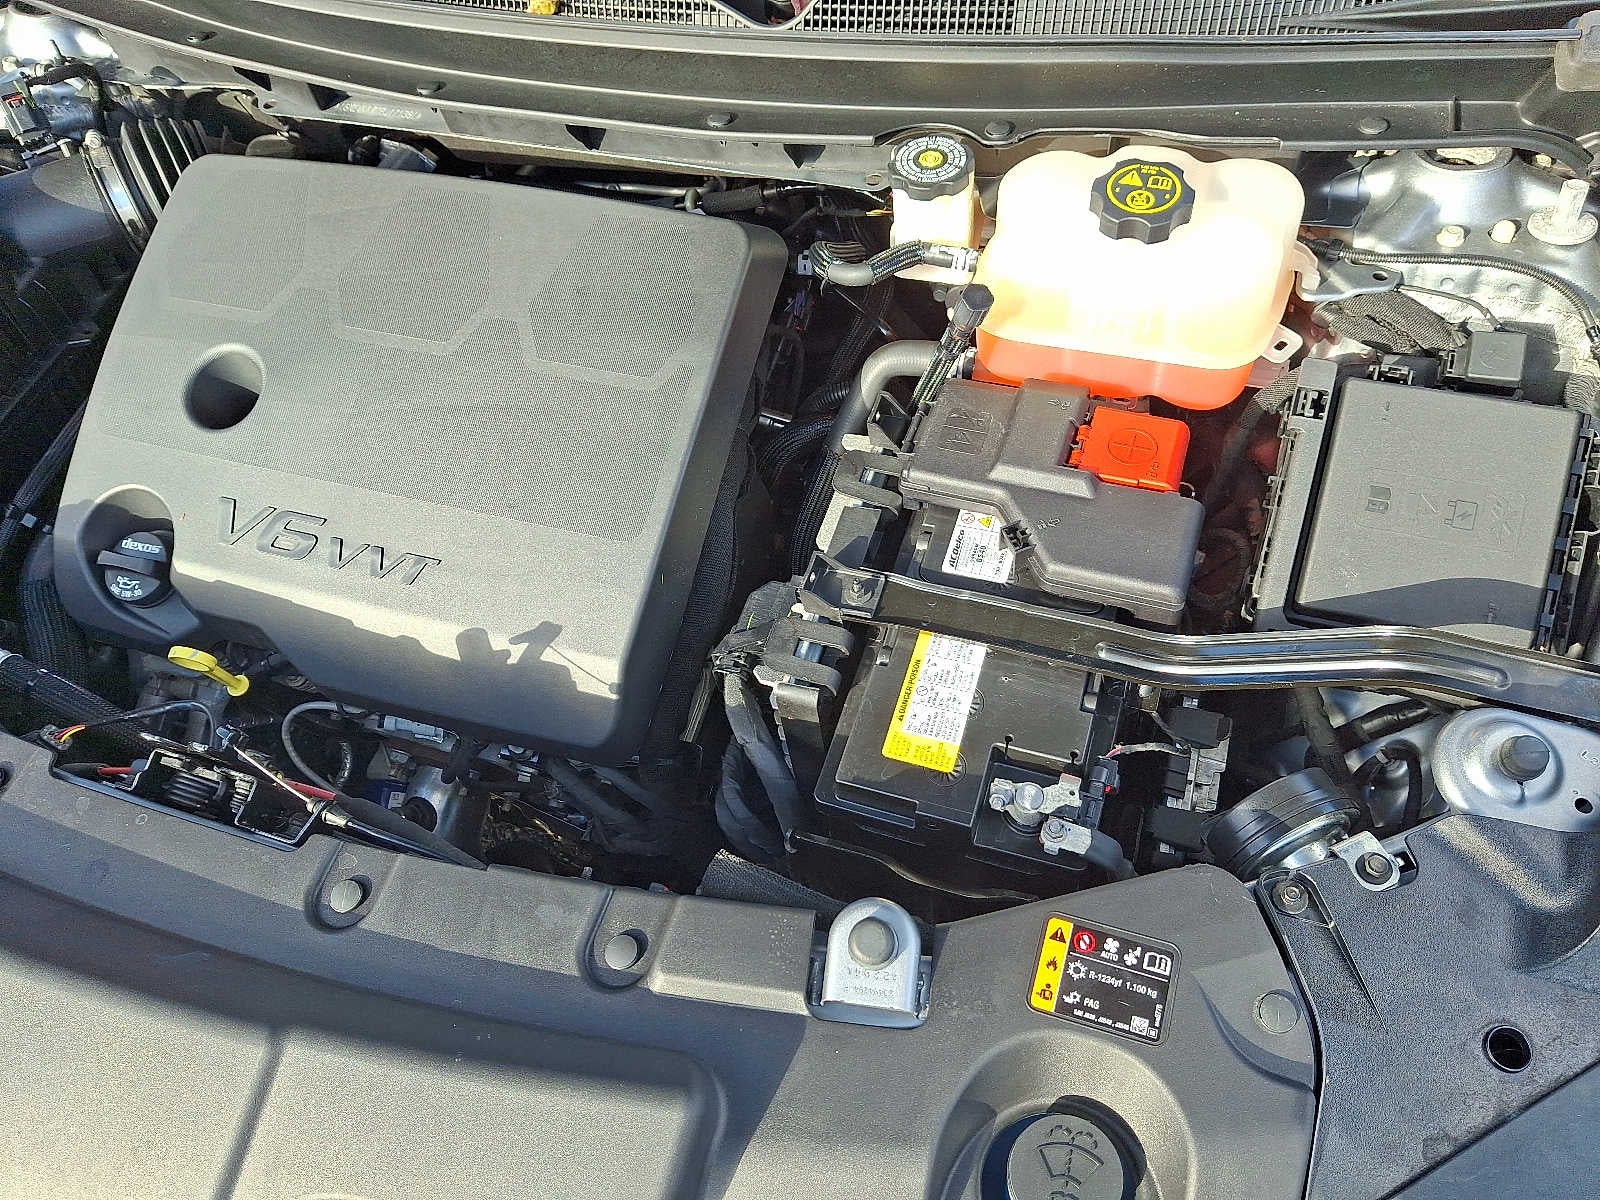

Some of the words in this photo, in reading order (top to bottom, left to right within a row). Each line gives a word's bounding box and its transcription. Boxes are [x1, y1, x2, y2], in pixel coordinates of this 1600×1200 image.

[121, 538, 163, 554] dexos
[218, 496, 327, 561] V6
[327, 536, 442, 586] VVT
[1100, 950, 1119, 962] AUTO
[1088, 970, 1123, 988] R-1234yf
[1125, 981, 1147, 995] 1.100
[1147, 987, 1158, 999] kg
[1083, 997, 1100, 1010] PAG
